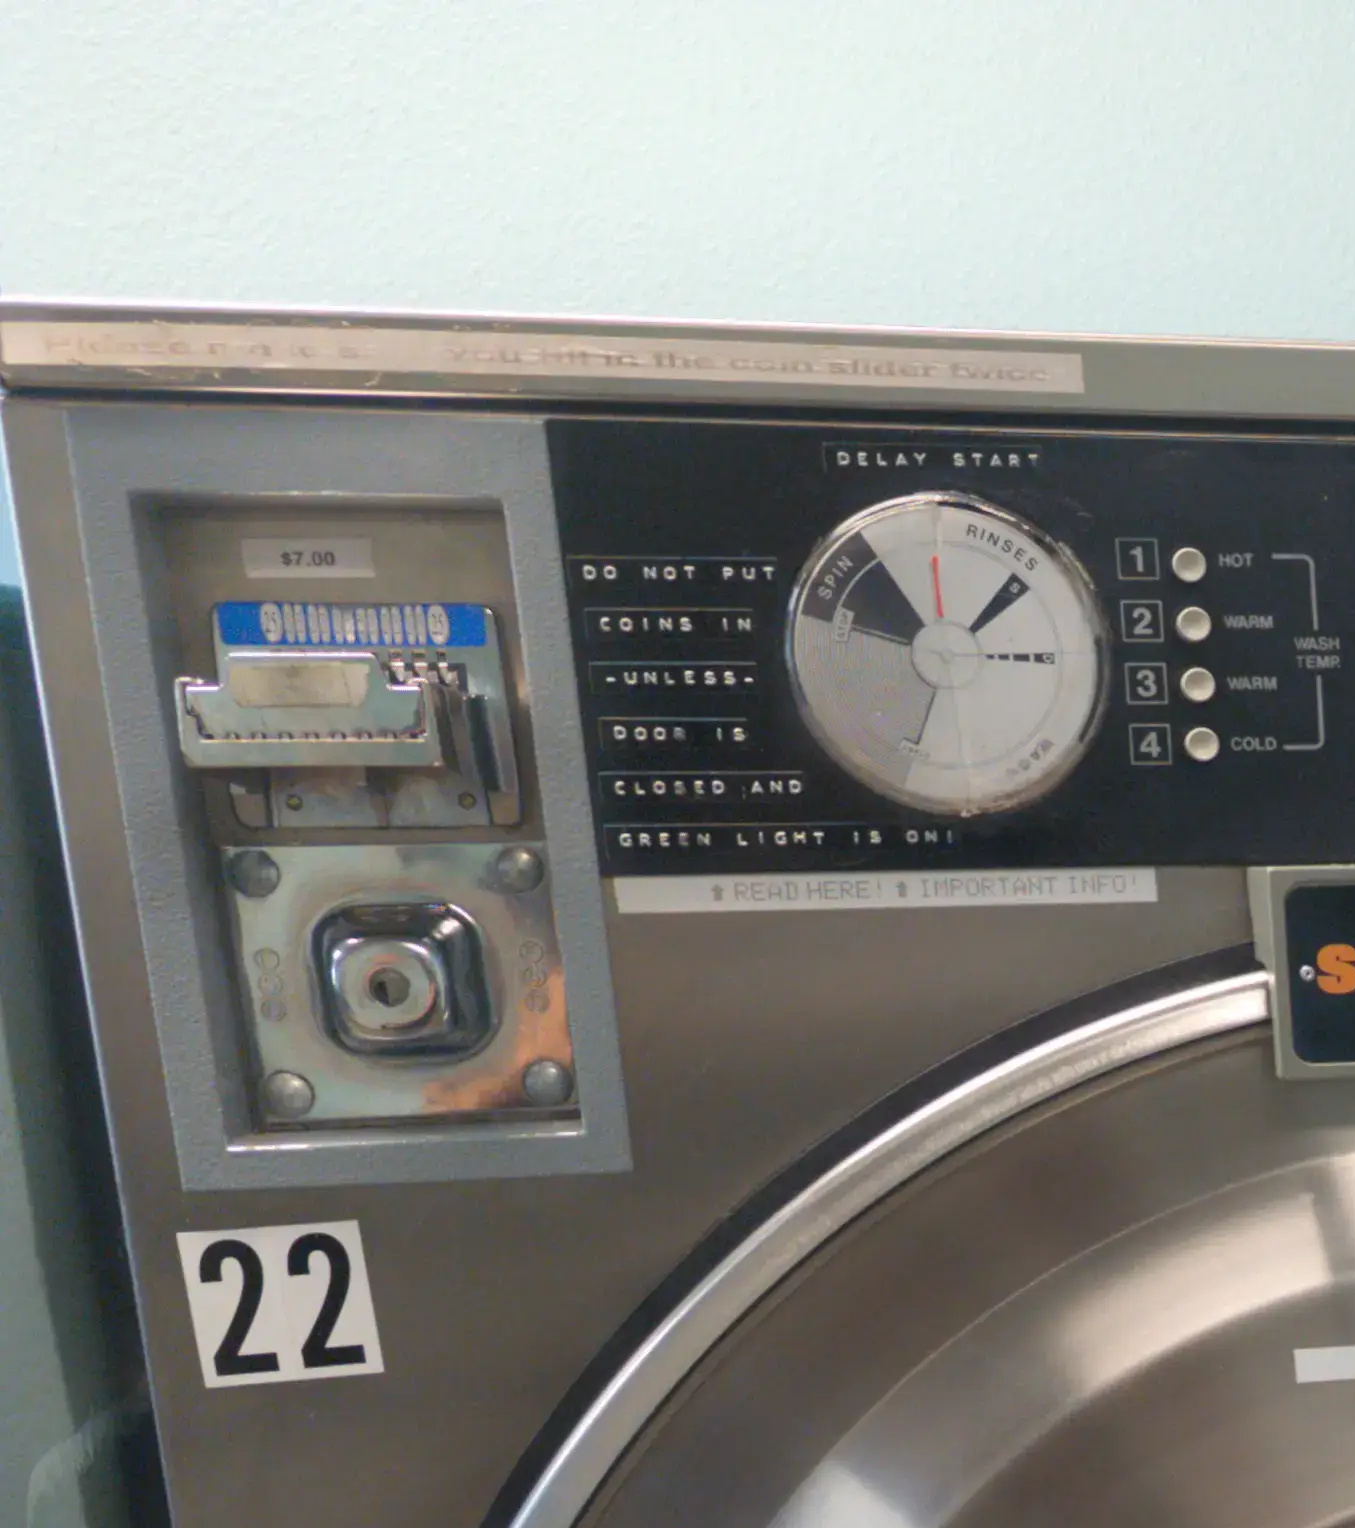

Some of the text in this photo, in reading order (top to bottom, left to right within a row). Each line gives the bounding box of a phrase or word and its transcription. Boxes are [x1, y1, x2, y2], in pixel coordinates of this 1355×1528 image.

[828, 358, 938, 378] slider
[837, 452, 1039, 468] DELAY START
[965, 524, 1039, 572] RINSES
[281, 551, 336, 567] $7.00
[1129, 546, 1253, 573] 1 HOT
[582, 565, 775, 580] DO NOT PUT
[817, 555, 854, 600] SPIN
[600, 616, 752, 632] COINS IN
[1132, 607, 1274, 635] 2 WARM
[1294, 636, 1340, 651] WASH
[1296, 655, 1341, 669] TEMP.
[1136, 670, 1278, 697] 3 WARM
[613, 725, 747, 742] DOOR IS
[1140, 732, 1277, 758] 4 COLD
[614, 780, 802, 795] CLOSED AND
[618, 828, 953, 847] GREEN LIGHT IS ON!
[734, 874, 1136, 902] READ HERE! IMPORTANT INFO!
[199, 1232, 367, 1377] 22
